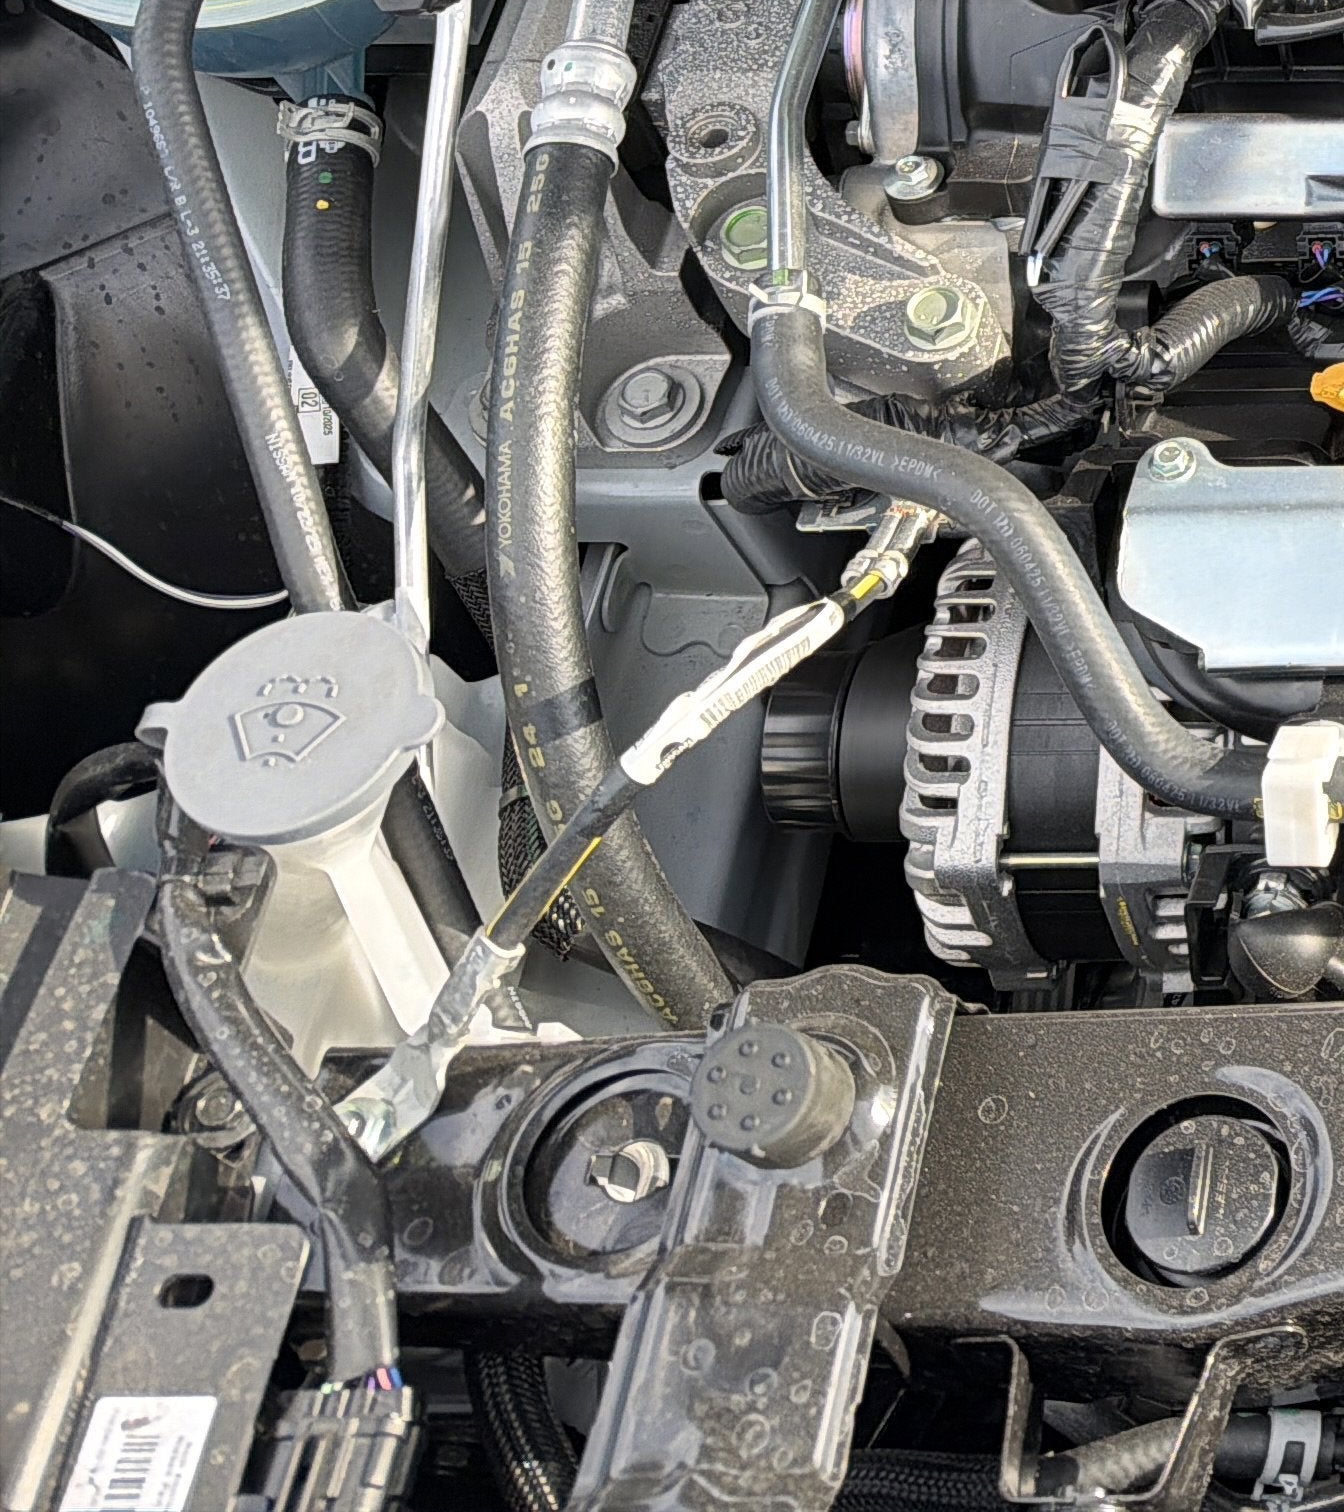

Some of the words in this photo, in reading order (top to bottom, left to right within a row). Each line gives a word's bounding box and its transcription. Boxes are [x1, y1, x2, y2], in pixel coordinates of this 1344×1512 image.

[188, 237, 234, 303] 21:35:37
[494, 439, 515, 549] YOKOHAMA
[513, 238, 534, 275] 15
[525, 151, 550, 215] 25G
[301, 391, 319, 408] 02
[966, 487, 998, 515] DOT
[1005, 534, 1047, 588] 060425
[578, 884, 608, 921] 15
